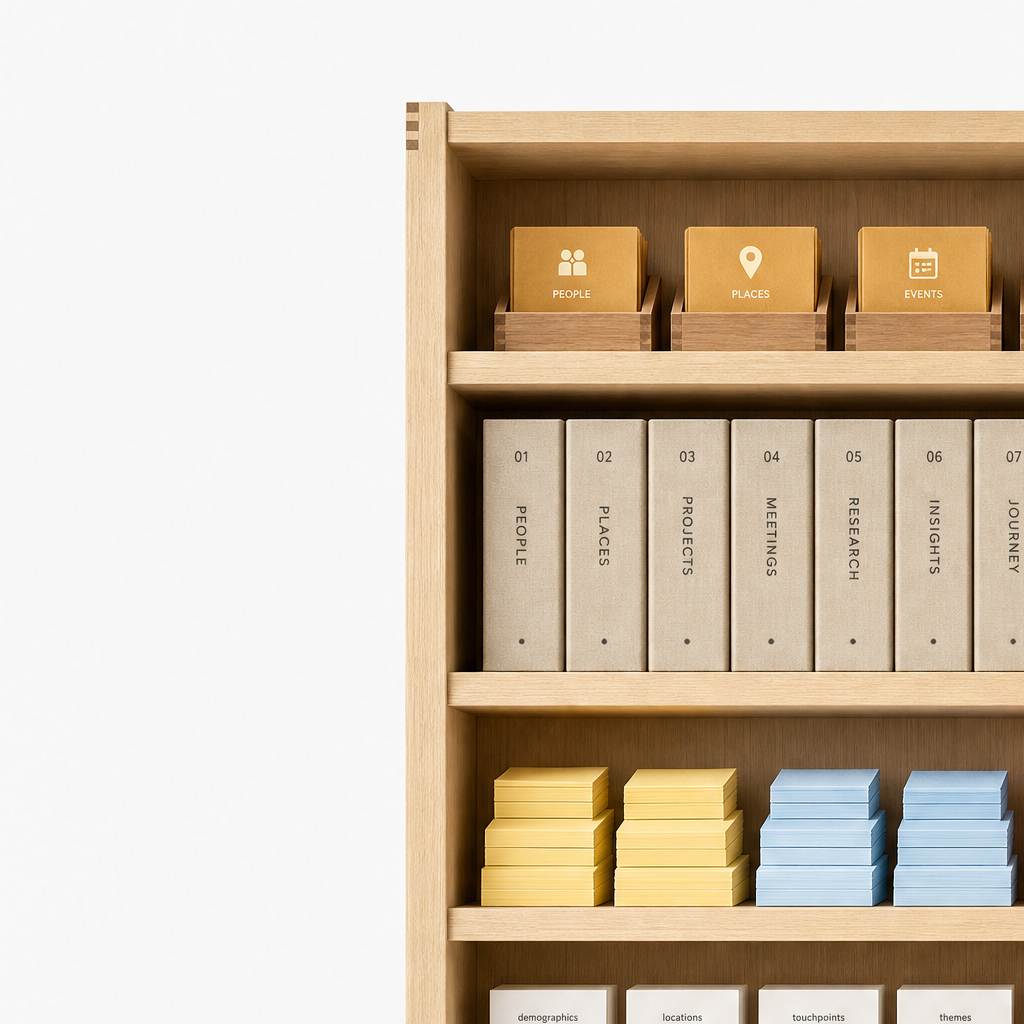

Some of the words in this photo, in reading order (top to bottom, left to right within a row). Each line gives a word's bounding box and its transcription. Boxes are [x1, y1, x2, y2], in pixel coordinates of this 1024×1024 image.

[552, 289, 591, 299] PEOPLE
[731, 289, 770, 299] PLACES
[904, 289, 943, 299] EVENTS
[514, 450, 528, 463] 01
[596, 450, 613, 463] 02
[679, 450, 696, 463] 03
[763, 450, 780, 463] 04
[845, 450, 862, 463] 05
[926, 450, 943, 463] 06
[1005, 450, 1022, 463] 07
[515, 505, 527, 566] PEOPLE
[598, 505, 610, 567] PLACES
[682, 496, 694, 576] PROJECTS
[766, 497, 778, 577] MEETINGS
[848, 497, 860, 580] RESEARCH
[929, 500, 941, 575] INSIGHTS
[1008, 499, 1020, 574] JOURNEY
[517, 1012, 579, 1024] demographics
[662, 1012, 703, 1022] locations
[792, 1012, 846, 1024] touchpoints
[939, 1012, 972, 1022] themes
